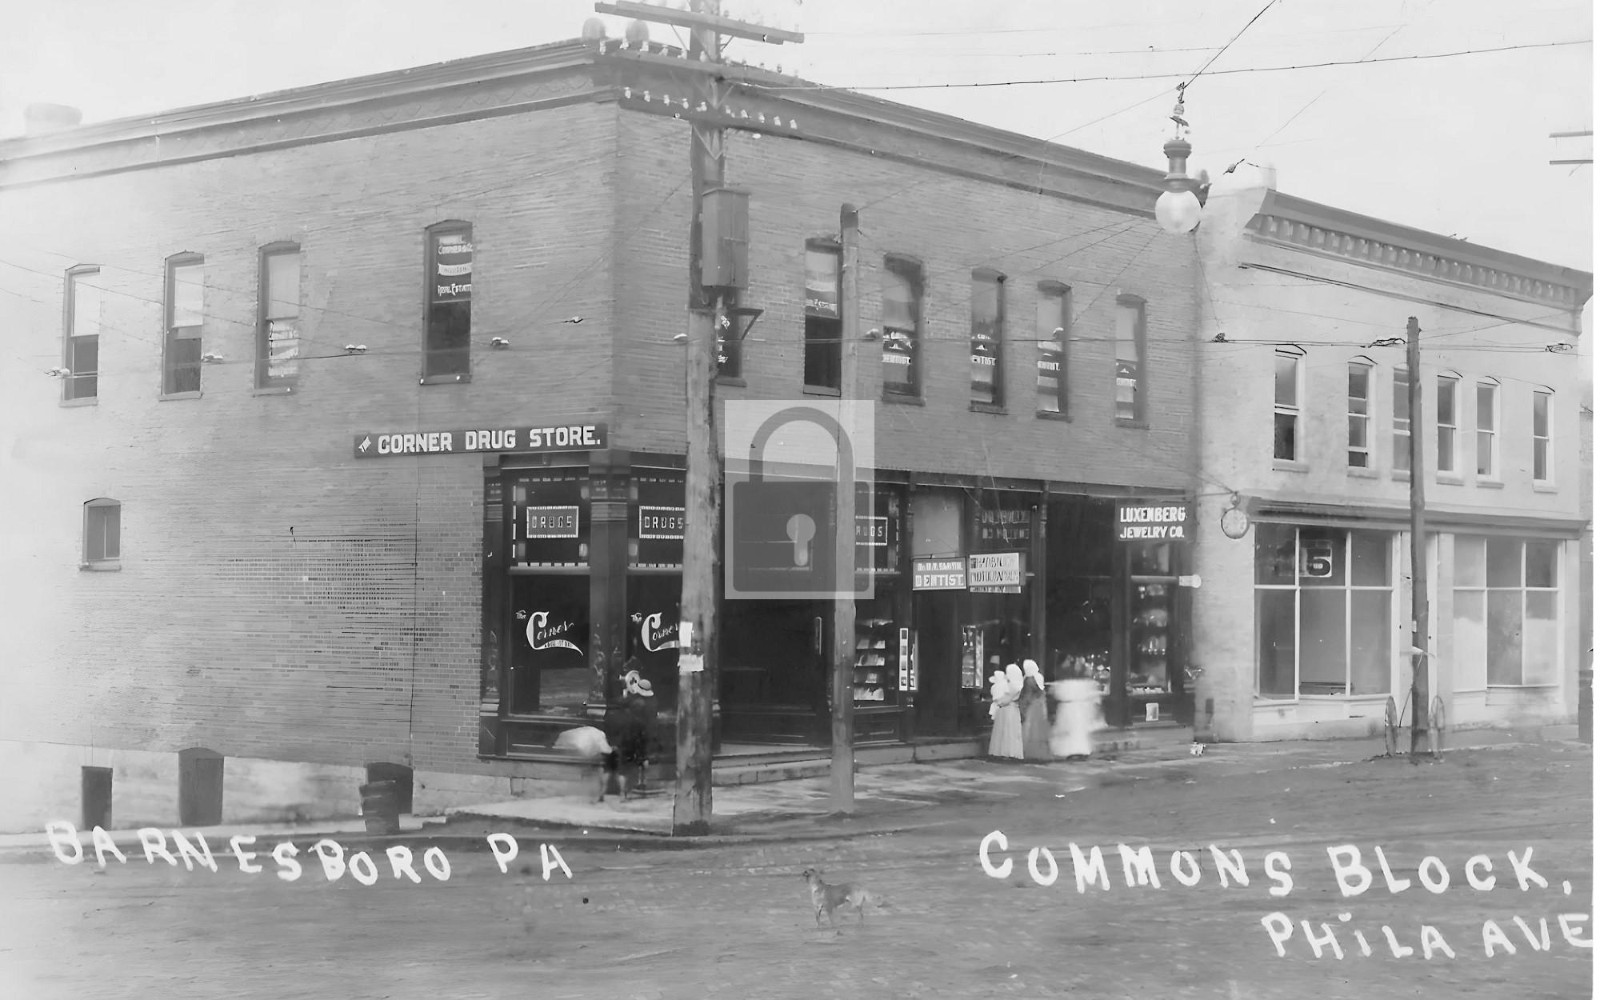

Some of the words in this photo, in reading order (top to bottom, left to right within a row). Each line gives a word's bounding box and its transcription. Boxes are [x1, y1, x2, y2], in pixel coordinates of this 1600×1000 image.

[377, 432, 453, 455] CORNER
[465, 429, 517, 451] DRUG
[529, 425, 601, 448] STORE.
[1120, 506, 1186, 522] LUXENBERG
[532, 515, 573, 529] DRUGS
[644, 516, 684, 530] DRUGS
[855, 525, 884, 537] RUGS
[1119, 525, 1168, 539] JEWELRY
[1169, 525, 1185, 538] CO.
